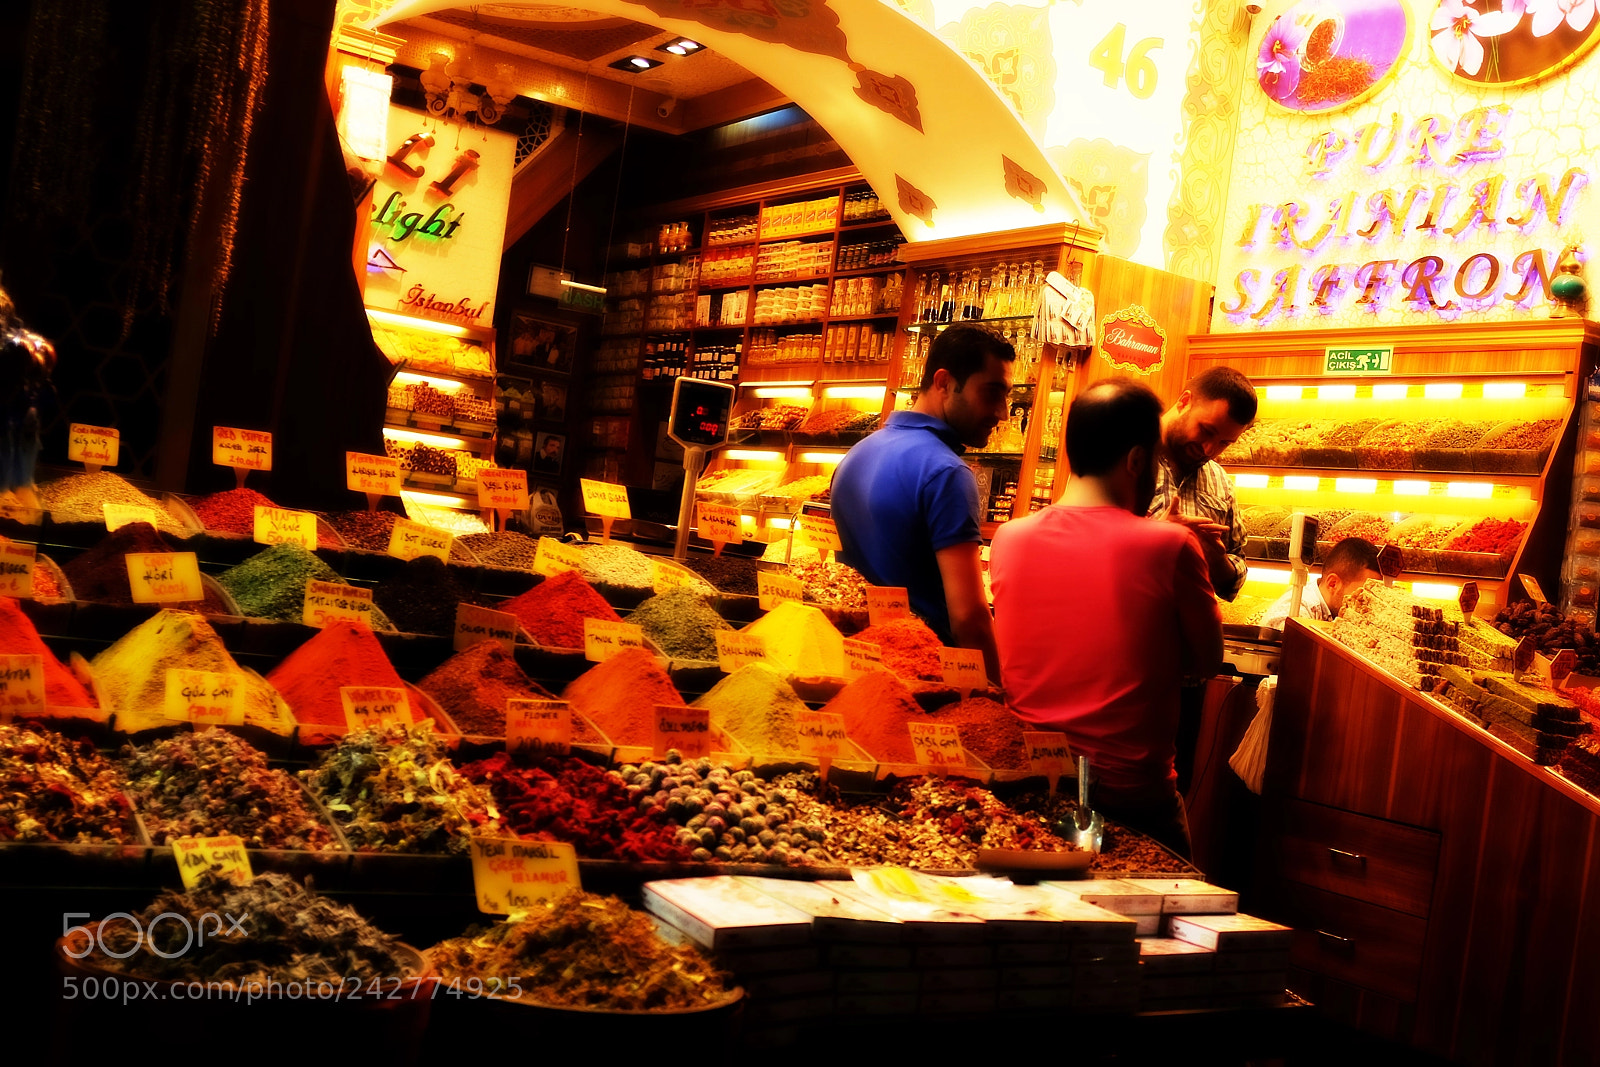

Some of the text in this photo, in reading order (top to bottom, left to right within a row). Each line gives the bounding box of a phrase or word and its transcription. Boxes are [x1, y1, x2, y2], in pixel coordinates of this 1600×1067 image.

[1088, 21, 1165, 100] 46
[1302, 103, 1512, 176] PURE
[1234, 166, 1590, 251] IRANIAN
[1219, 246, 1580, 321] SAFFRON
[1104, 327, 1160, 355] Bahraman
[1328, 361, 1357, 371] ÇIKIŞ
[1329, 350, 1354, 360] ACİL
[260, 508, 303, 525] MINT
[522, 711, 558, 722] FLOWER
[182, 852, 209, 869] ADA
